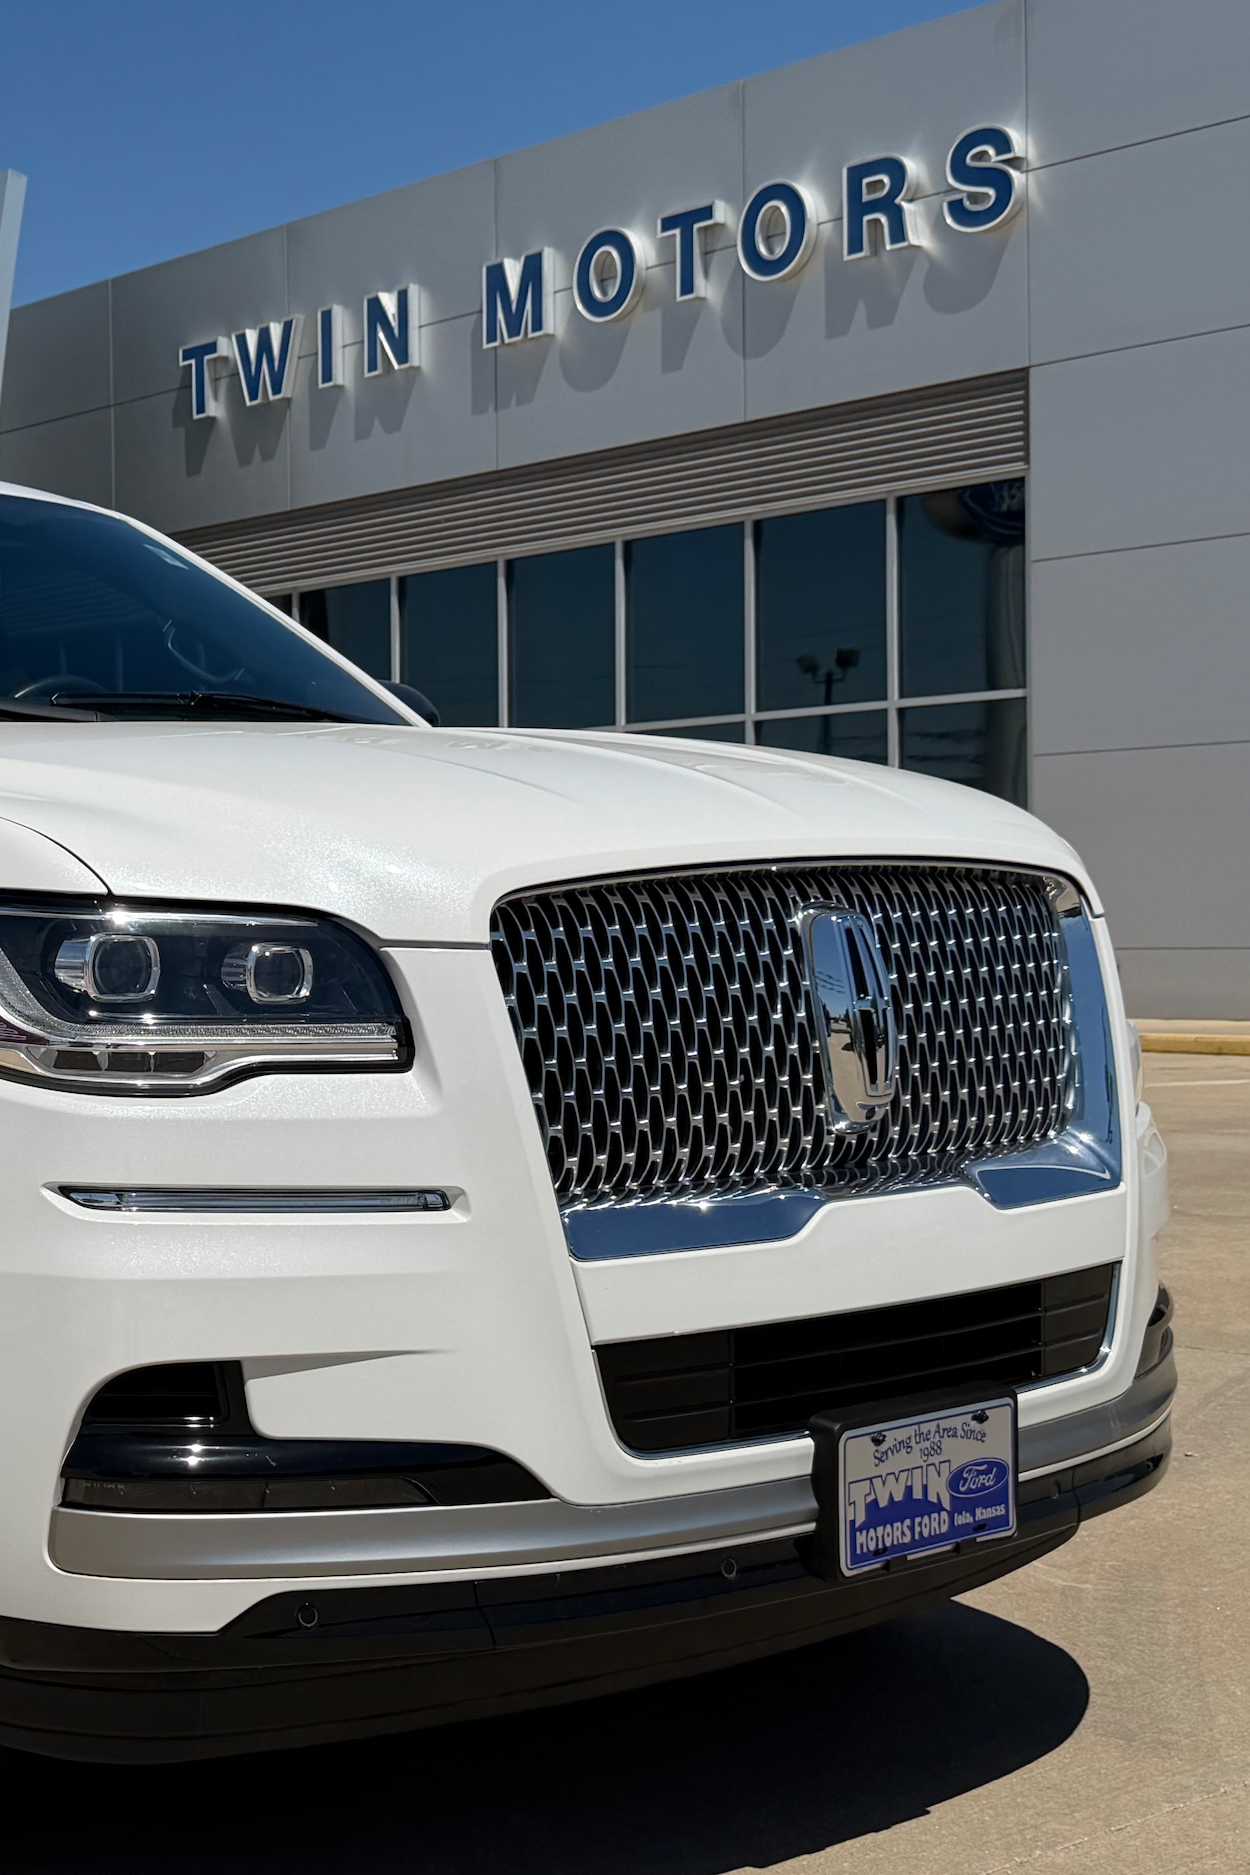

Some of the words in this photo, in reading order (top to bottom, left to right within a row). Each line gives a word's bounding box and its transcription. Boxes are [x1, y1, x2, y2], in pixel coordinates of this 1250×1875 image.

[178, 283, 421, 420] TWIN
[482, 124, 1026, 350] MOTORS
[873, 1435, 914, 1467] Serving
[914, 1423, 931, 1445] the
[933, 1422, 958, 1440] Area
[960, 1421, 987, 1443] Since
[919, 1440, 942, 1463] 1988
[848, 1460, 951, 1528] TWIN
[959, 1464, 996, 1492] Ford
[856, 1518, 911, 1554] MOTORS
[914, 1511, 949, 1540] FORD
[954, 1511, 973, 1527] Iola,
[975, 1503, 1006, 1519] Kansas
